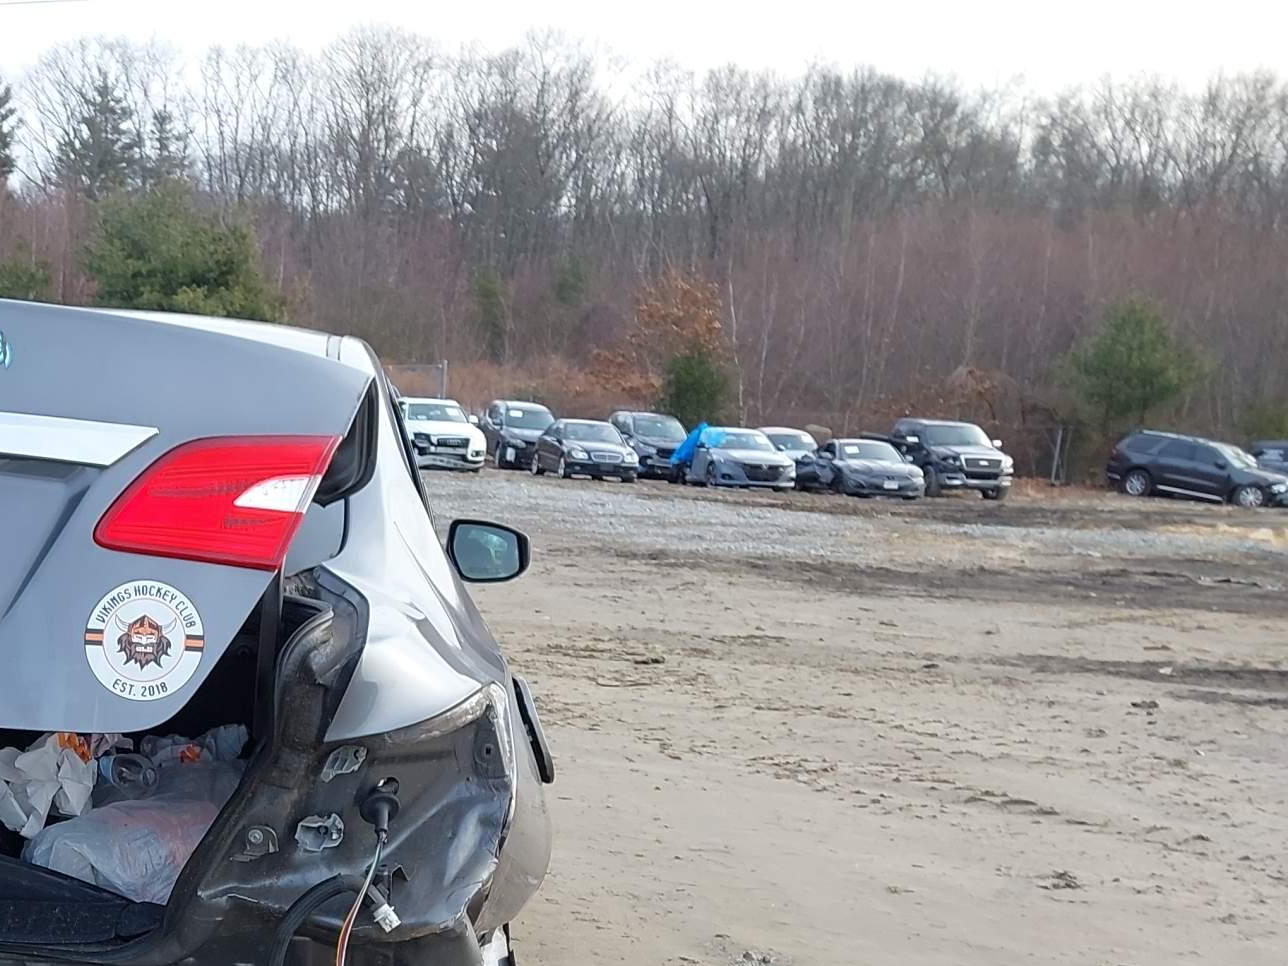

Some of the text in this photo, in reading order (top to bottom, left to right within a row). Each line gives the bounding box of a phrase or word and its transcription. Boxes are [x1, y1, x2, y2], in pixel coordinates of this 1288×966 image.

[95, 585, 197, 629] VIKINGS HOCKEY CLUB
[112, 678, 169, 698] EST. 2018
